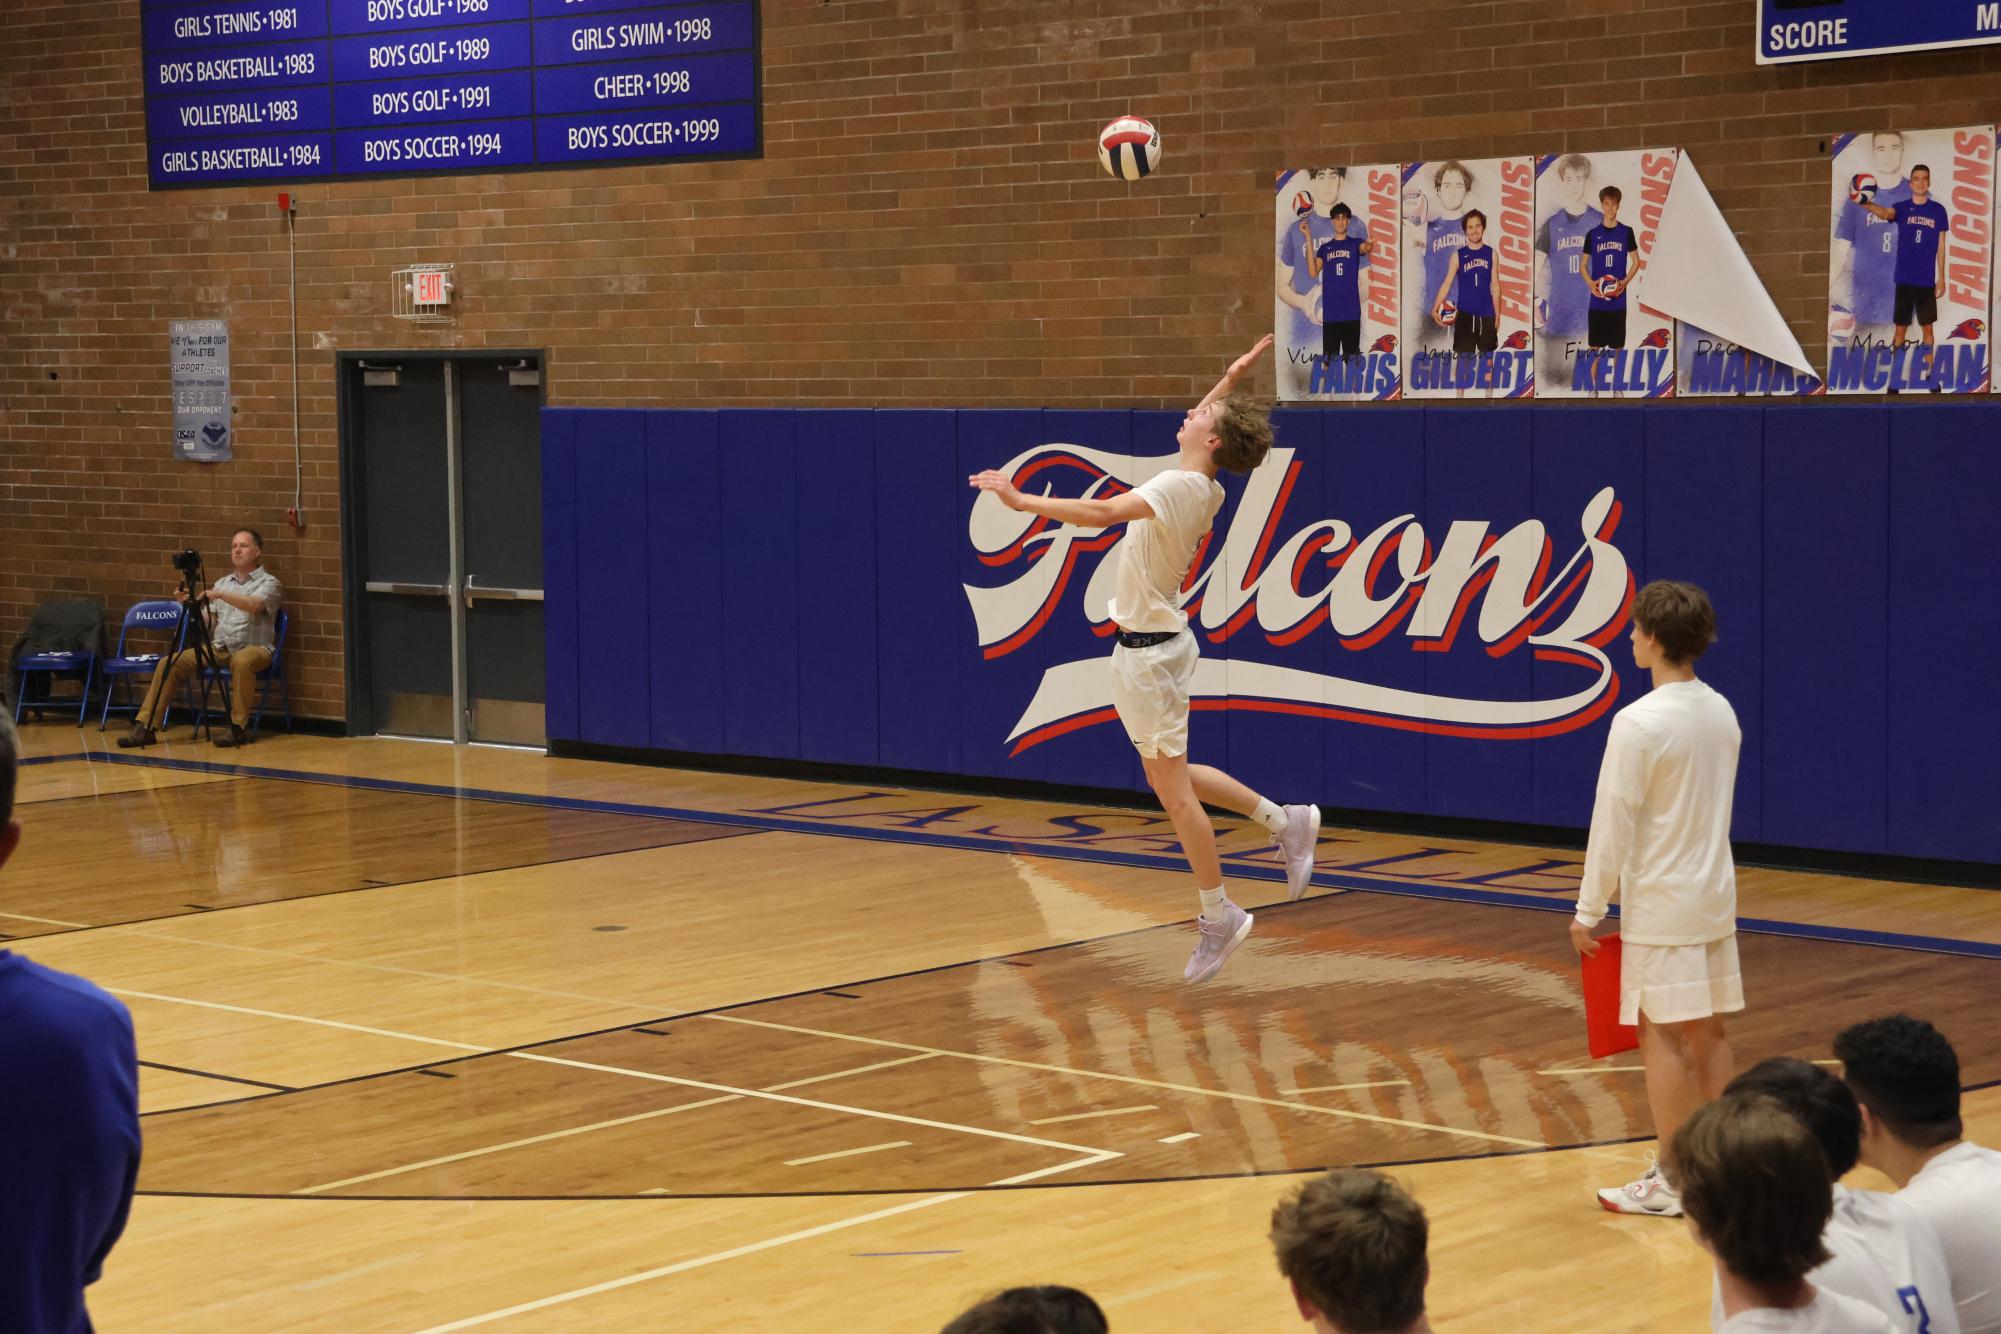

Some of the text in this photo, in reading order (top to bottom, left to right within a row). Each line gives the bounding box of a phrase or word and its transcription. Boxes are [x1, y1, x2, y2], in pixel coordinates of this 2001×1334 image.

[368, 0, 404, 22] BOYS
[174, 16, 212, 38] GIRLS
[1770, 2, 2001, 50] SCORE M
[572, 26, 616, 51] GIRLS
[370, 45, 406, 68] BOYS
[160, 63, 194, 84] BOYS
[372, 92, 409, 115] BOYS
[568, 126, 608, 149] BOYS
[162, 152, 198, 172] GIRLS
[365, 140, 400, 162] BOYS
[1907, 216, 1936, 228] FALCONS
[1949, 131, 1992, 311] FALCONS
[1500, 160, 1532, 324] FALCONS
[1597, 242, 1622, 252] FALCONS
[1883, 232, 1891, 252] 8
[1916, 230, 1922, 243] 8
[1327, 250, 1350, 261] FALCONS
[1368, 170, 1398, 327] FALCONS
[1464, 258, 1488, 272] FALCONS
[1569, 255, 1579, 274] 10
[1606, 254, 1613, 267] 10
[420, 274, 441, 300] EXIT
[199, 336, 212, 345] FOR
[214, 336, 227, 344] OUR
[181, 348, 216, 357] ATHLETES
[172, 364, 204, 372] SUPPORT
[1310, 353, 1397, 395] FARIS
[1410, 351, 1534, 390] GILBERT
[1571, 349, 1669, 391] KELLY
[1828, 344, 1986, 391] MCLEAN
[192, 406, 222, 414] OPPONENT
[136, 610, 177, 620] FALCONS
